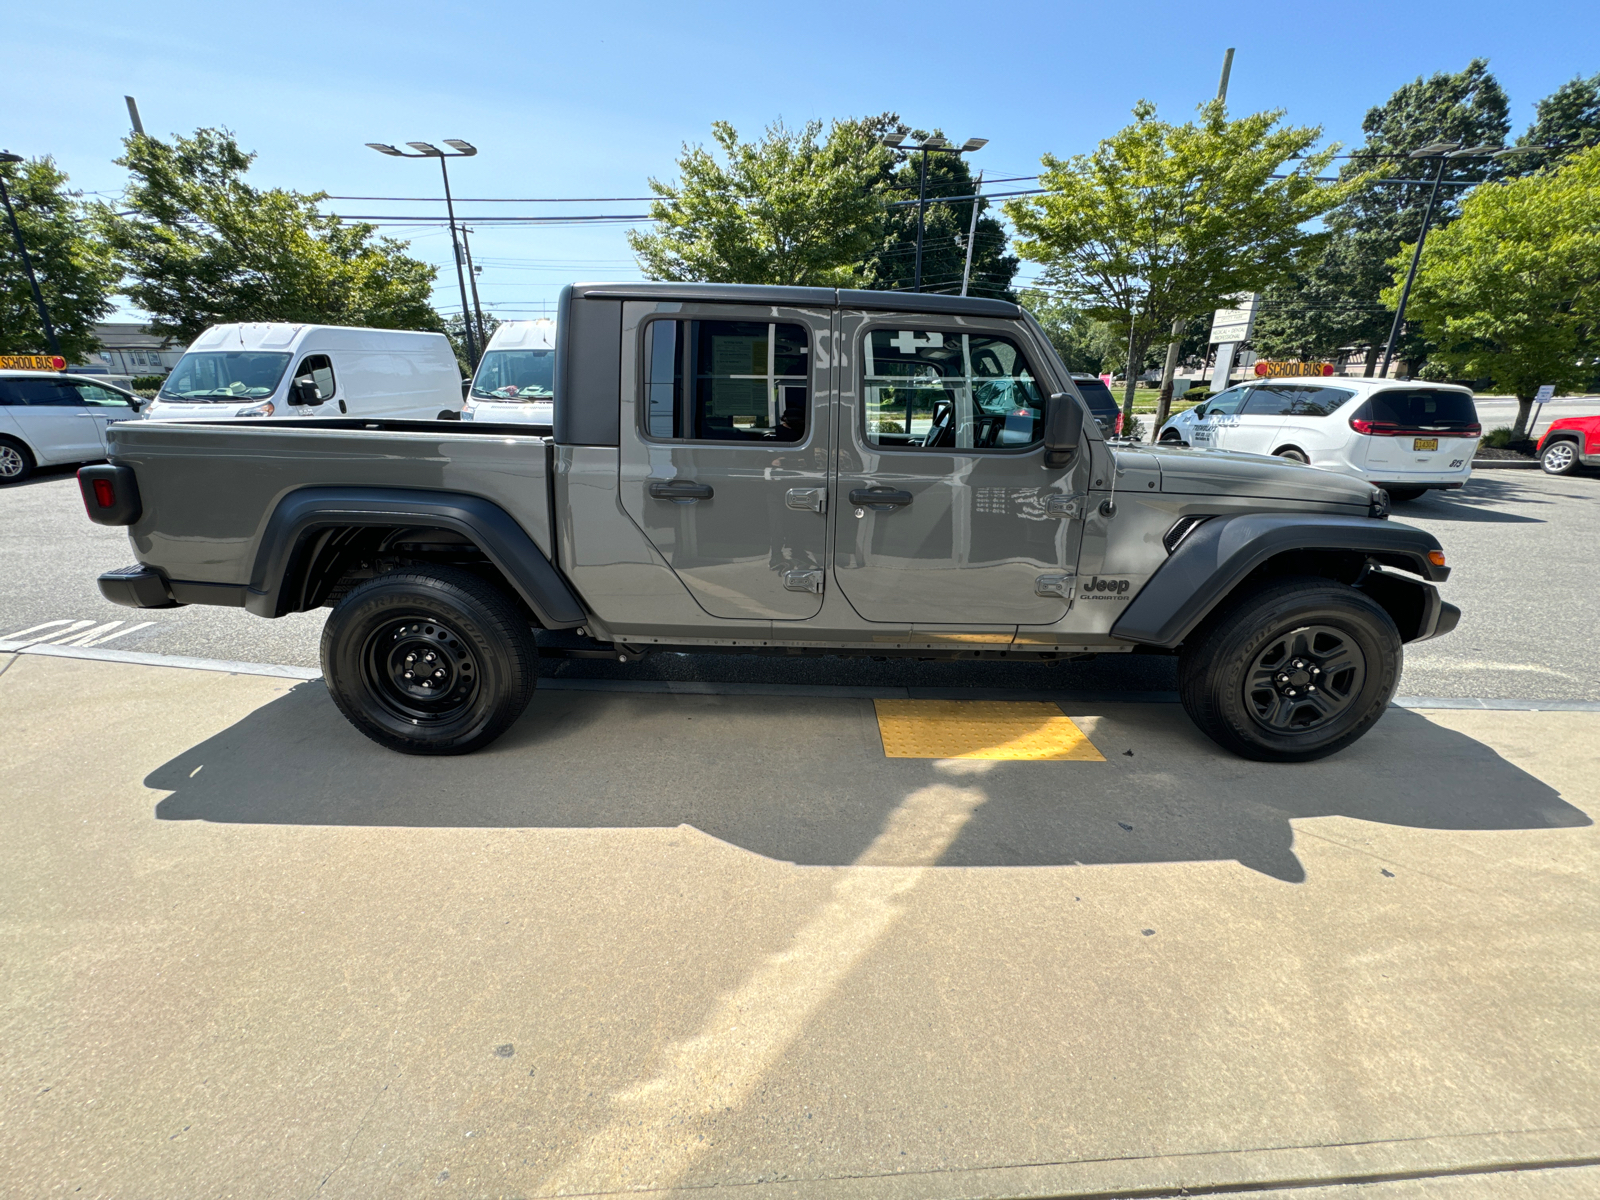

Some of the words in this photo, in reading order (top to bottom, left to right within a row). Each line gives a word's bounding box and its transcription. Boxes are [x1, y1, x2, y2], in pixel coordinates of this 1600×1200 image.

[1, 356, 35, 369] SCHOOL
[35, 356, 53, 369] BUS
[1268, 362, 1302, 376] SCHOOL
[1302, 363, 1321, 376] BUS
[1449, 459, 1464, 467] 815
[1084, 576, 1129, 594] Jeep
